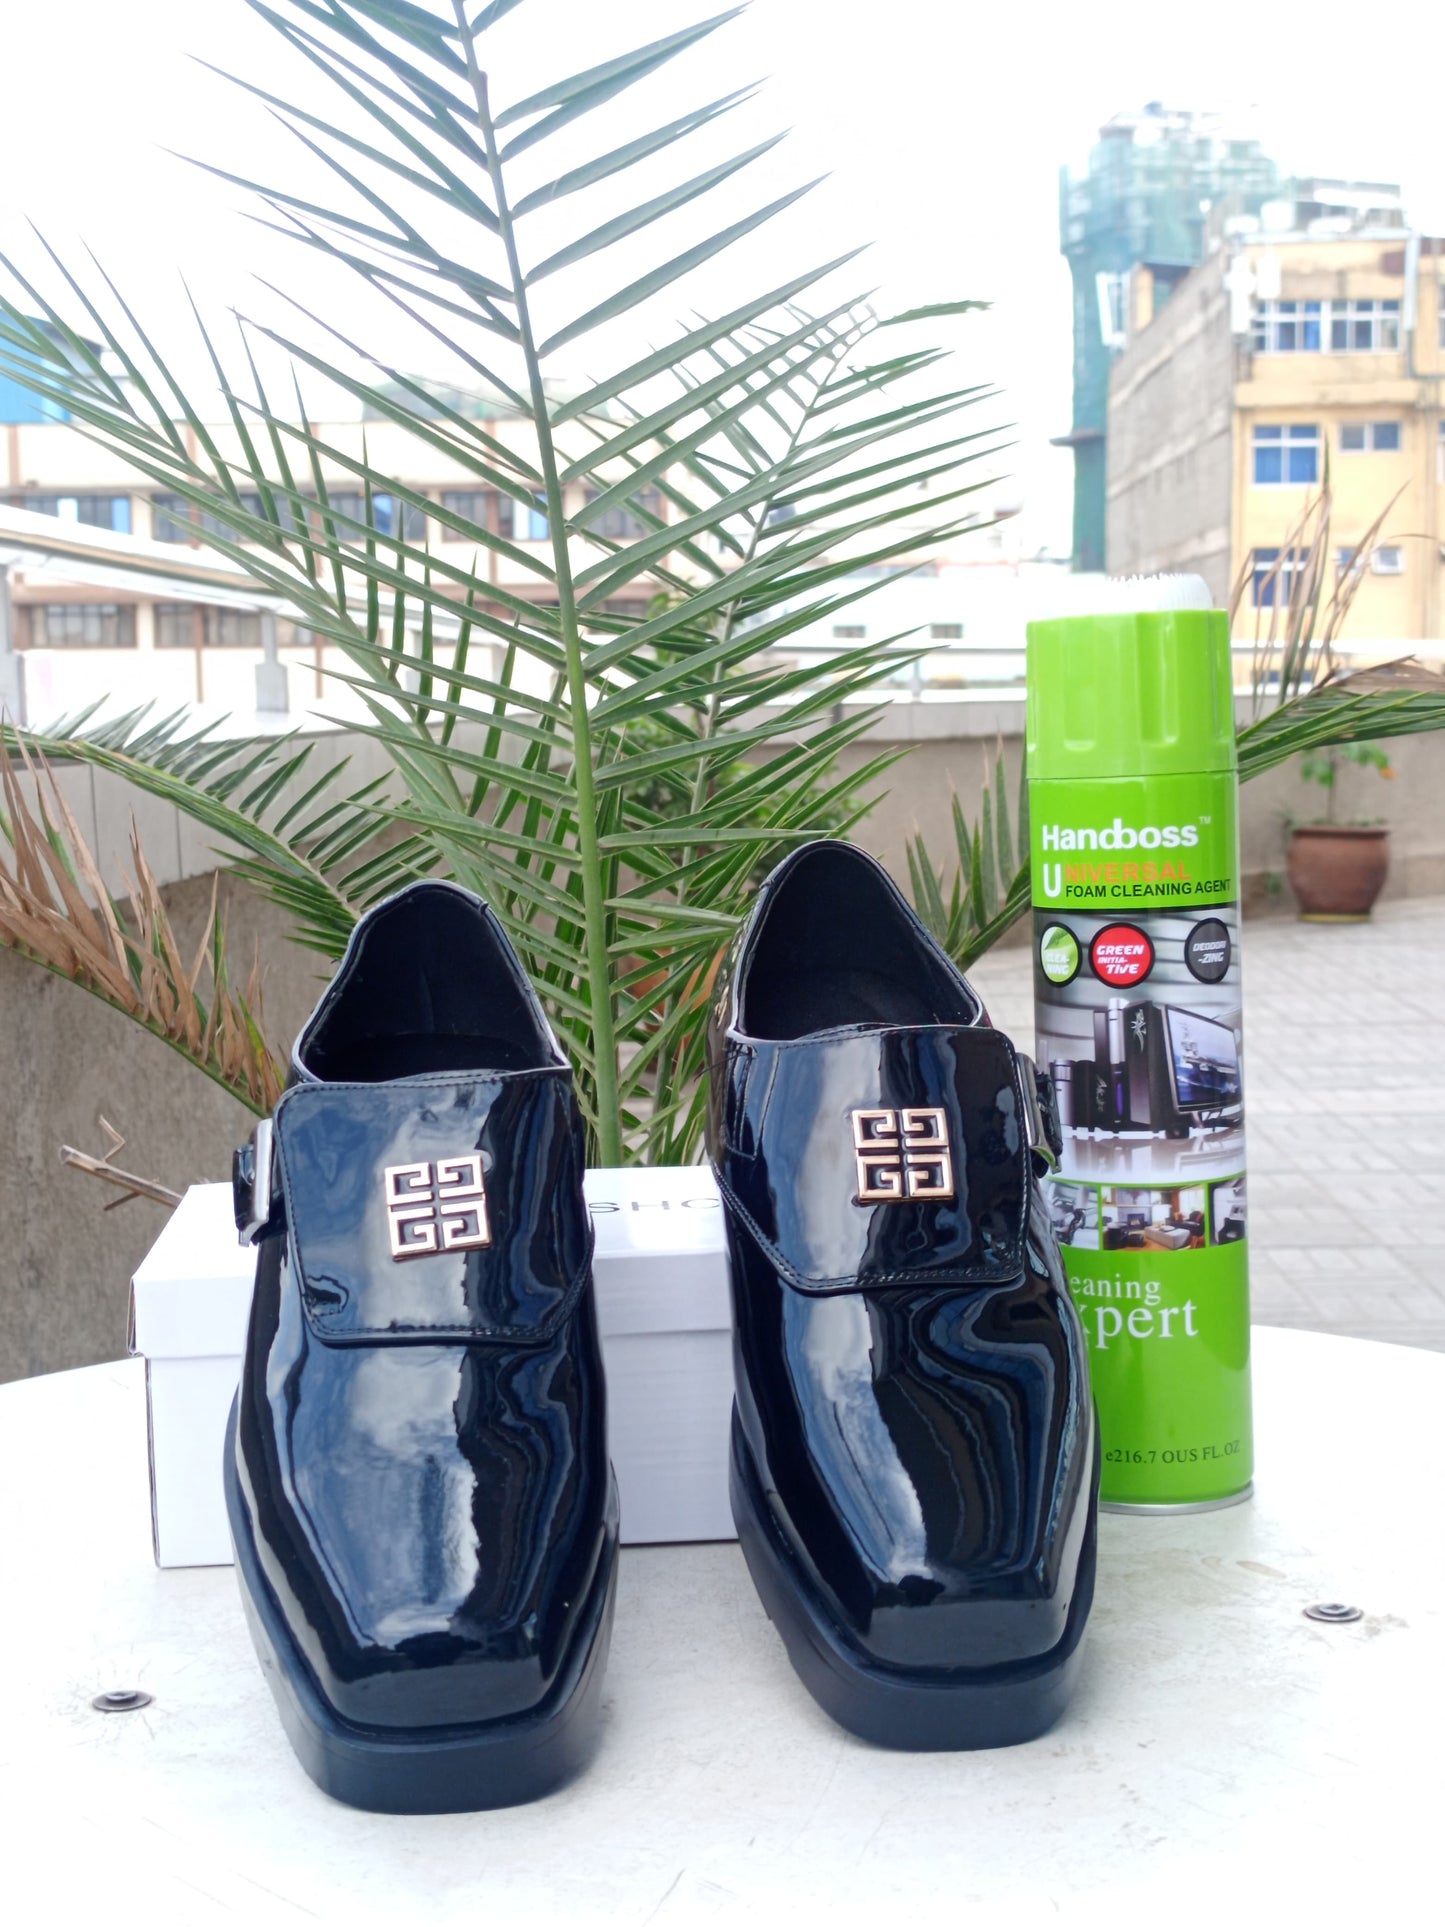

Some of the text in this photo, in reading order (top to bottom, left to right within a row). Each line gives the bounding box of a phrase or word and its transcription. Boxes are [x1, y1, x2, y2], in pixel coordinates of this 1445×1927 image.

[1042, 818, 1199, 851] Handboss
[1066, 879, 1231, 897] FOAM CLEANING AGENT
[1096, 945, 1144, 955] GREEN
[1106, 963, 1140, 974] TIVE
[1161, 1448, 1198, 1463] OUS
